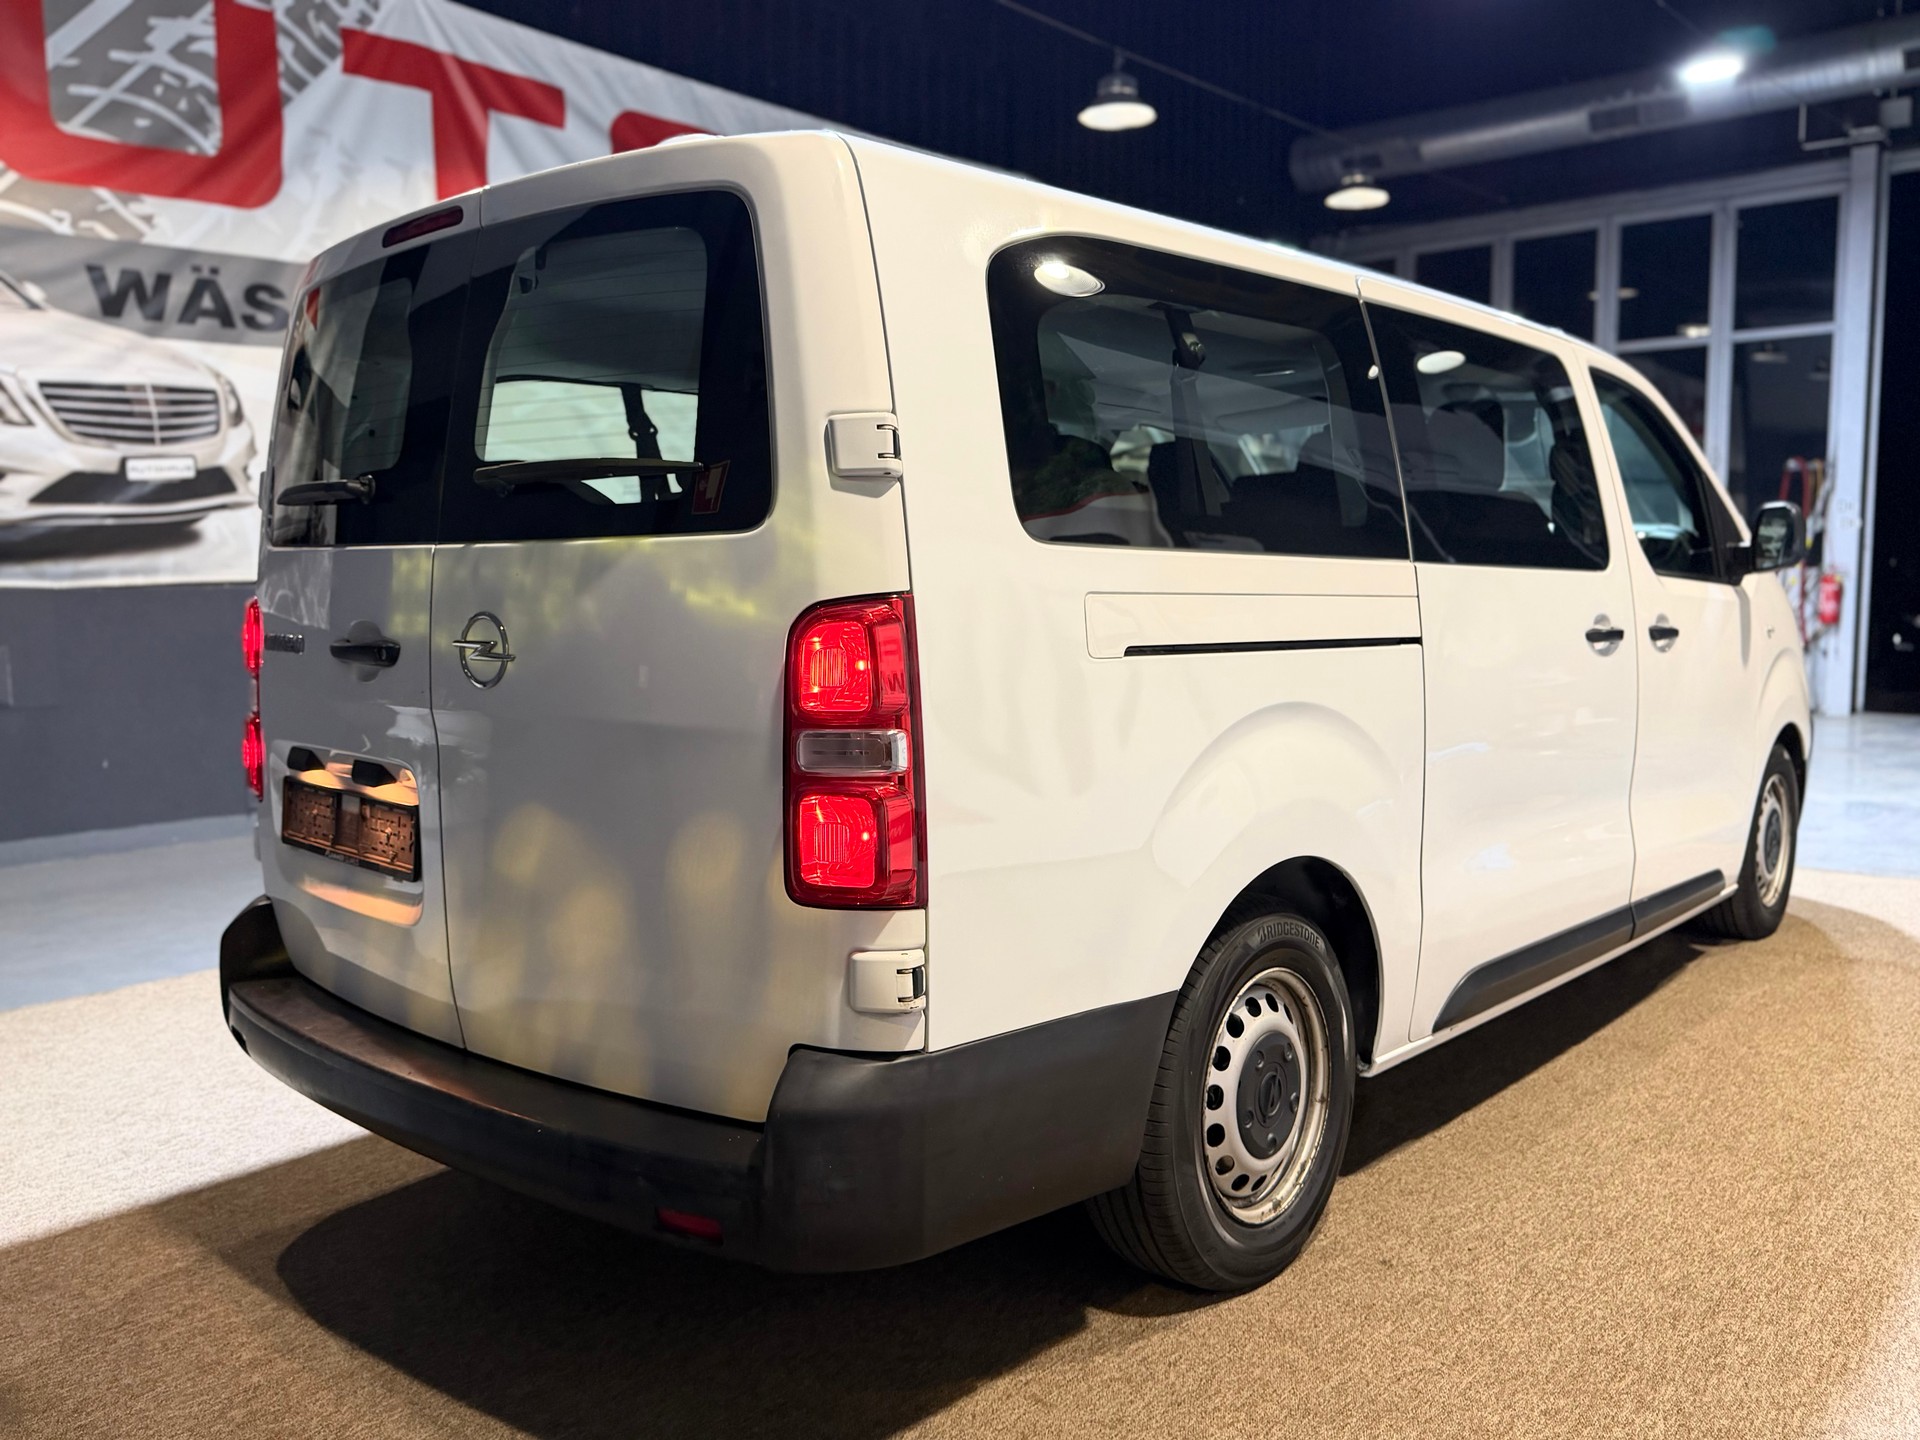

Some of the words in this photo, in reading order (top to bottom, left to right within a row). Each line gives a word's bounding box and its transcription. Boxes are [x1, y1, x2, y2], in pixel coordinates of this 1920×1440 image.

[0, 0, 722, 208] UT
[86, 264, 290, 332] WÄS
[1257, 921, 1320, 949] BRIDGESTONE
